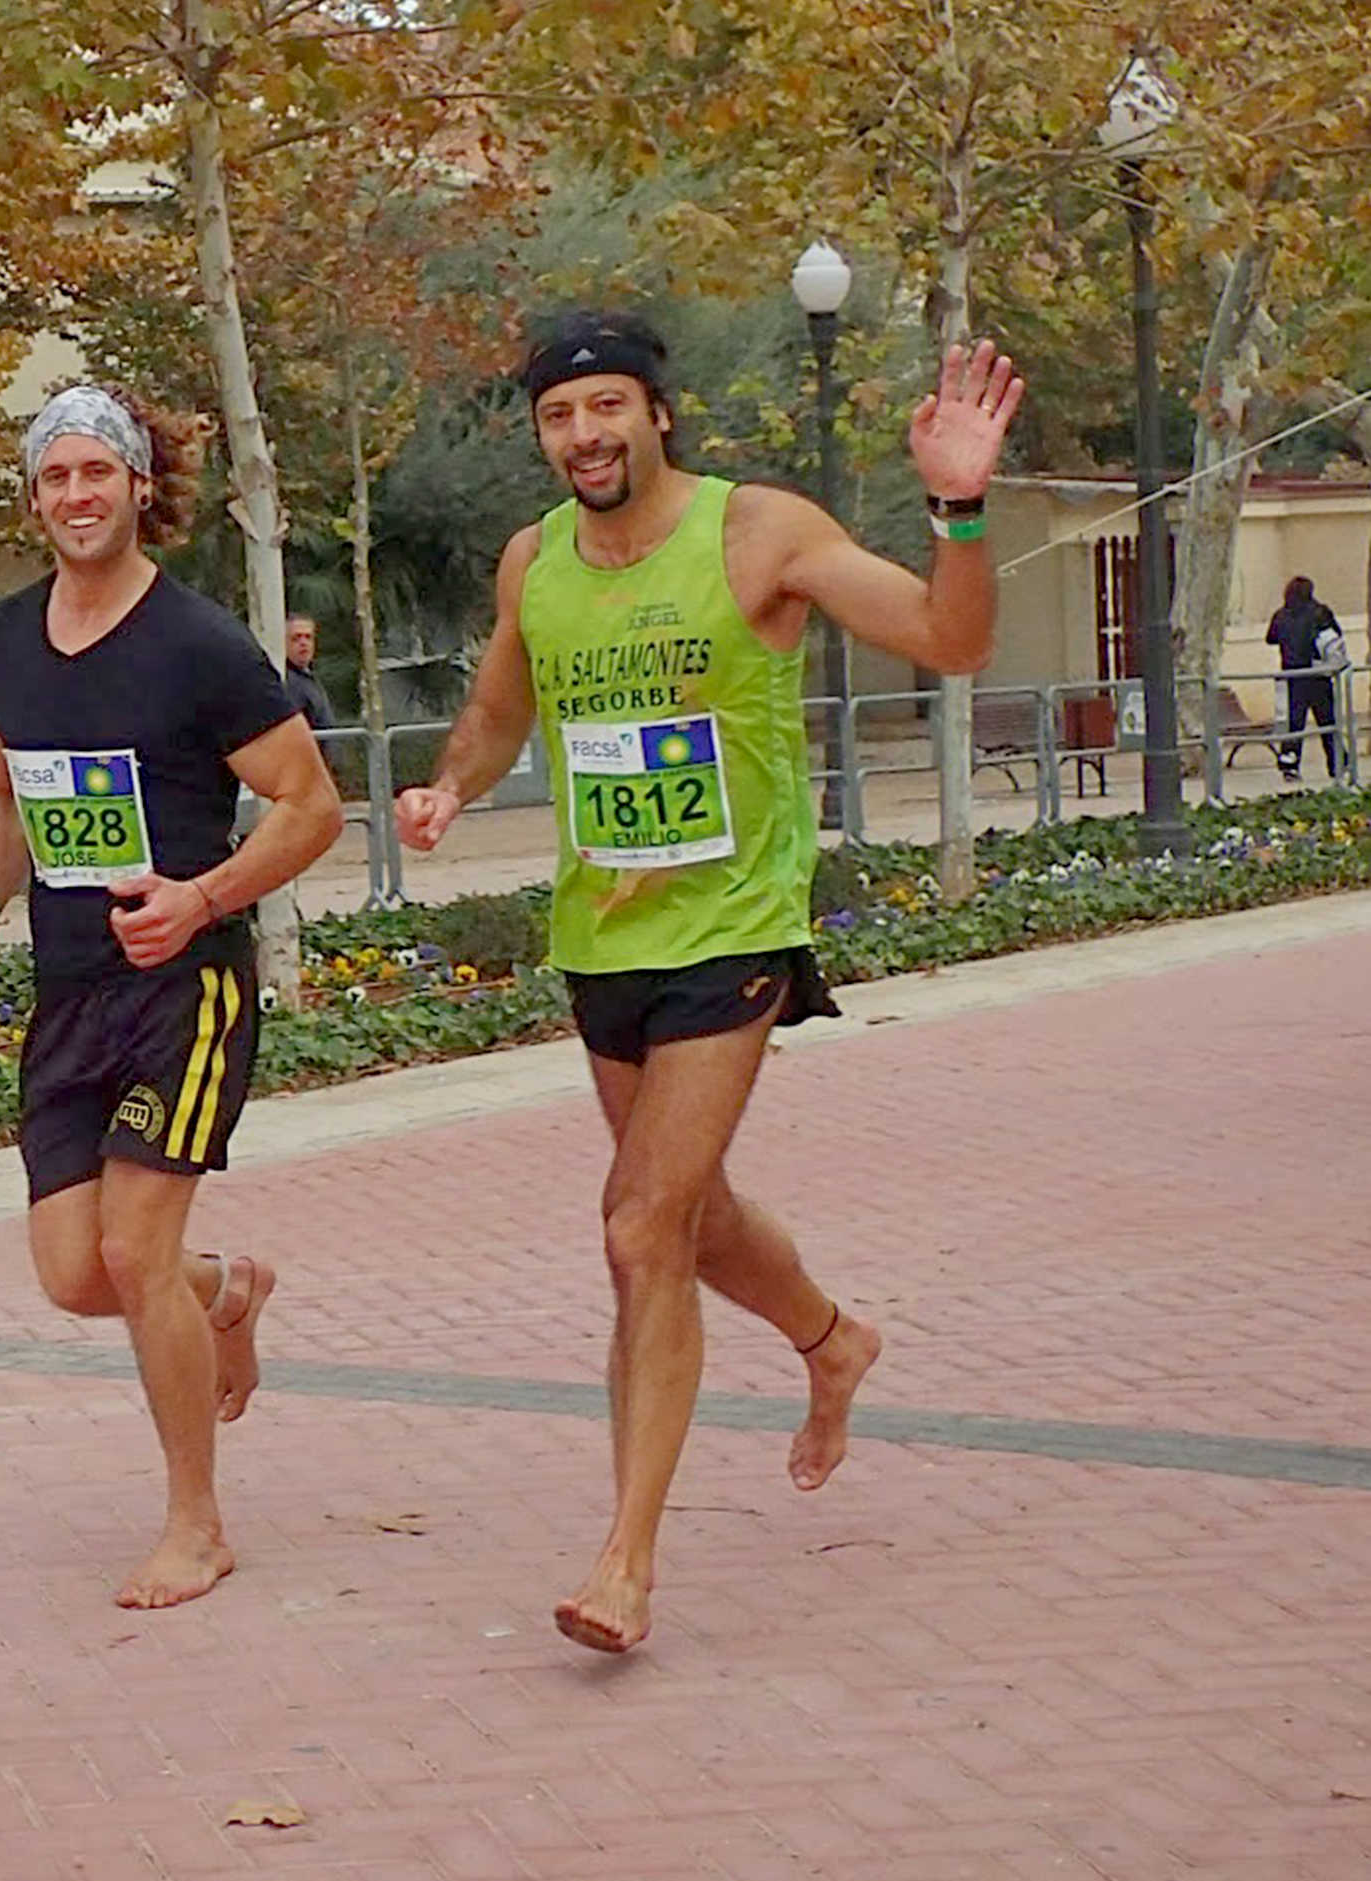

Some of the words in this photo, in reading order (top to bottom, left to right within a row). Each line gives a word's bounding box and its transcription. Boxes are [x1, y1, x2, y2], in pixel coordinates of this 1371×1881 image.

[572, 637, 712, 687] SALTAMONTES
[557, 685, 685, 719] SEGORBE
[587, 778, 708, 828] 1812
[613, 829, 682, 847] EMILIO
[50, 852, 98, 868] JOSE
